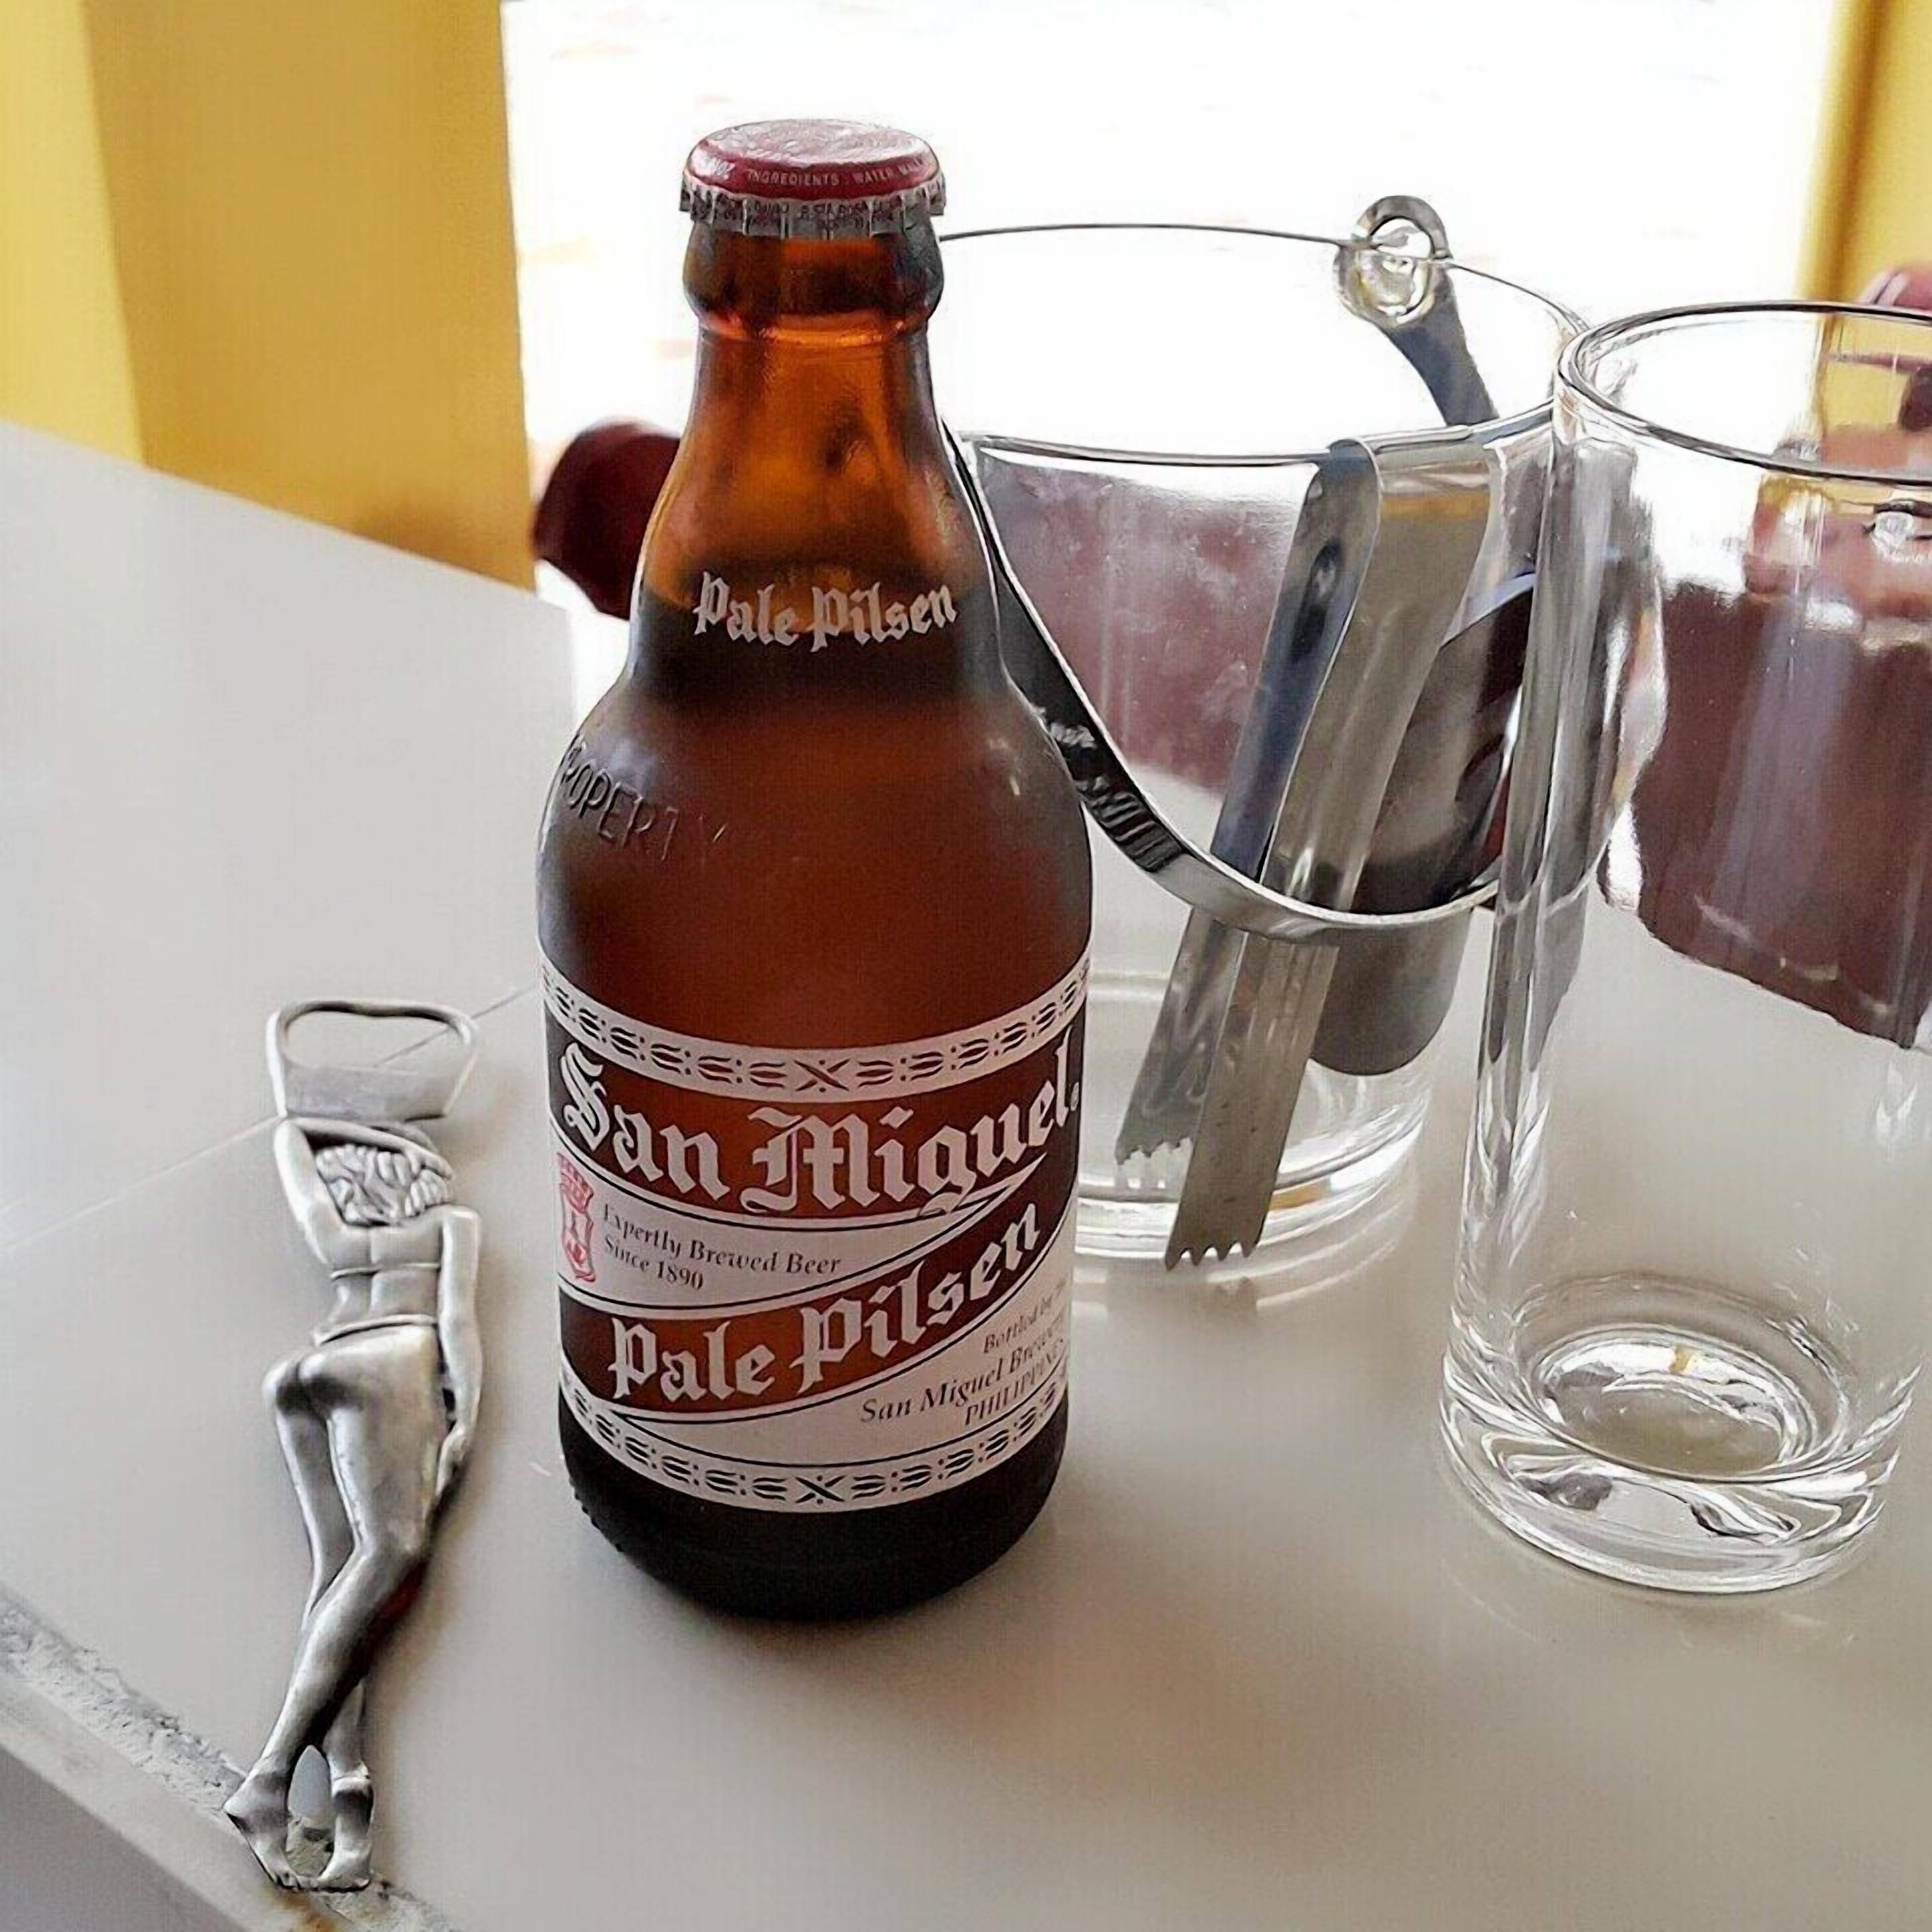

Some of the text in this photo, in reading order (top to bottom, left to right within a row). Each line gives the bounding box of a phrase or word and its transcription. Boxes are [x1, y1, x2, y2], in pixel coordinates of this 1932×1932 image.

[693, 571, 956, 653] Pale Pilsen
[560, 1042, 731, 1201] San
[604, 1203, 841, 1275] Expertly Brewed Beer
[605, 1234, 703, 1291] Since 1890
[608, 1203, 1040, 1403] Pale Pilsen
[861, 1399, 910, 1423] San
[920, 1357, 1003, 1412] Miguel
